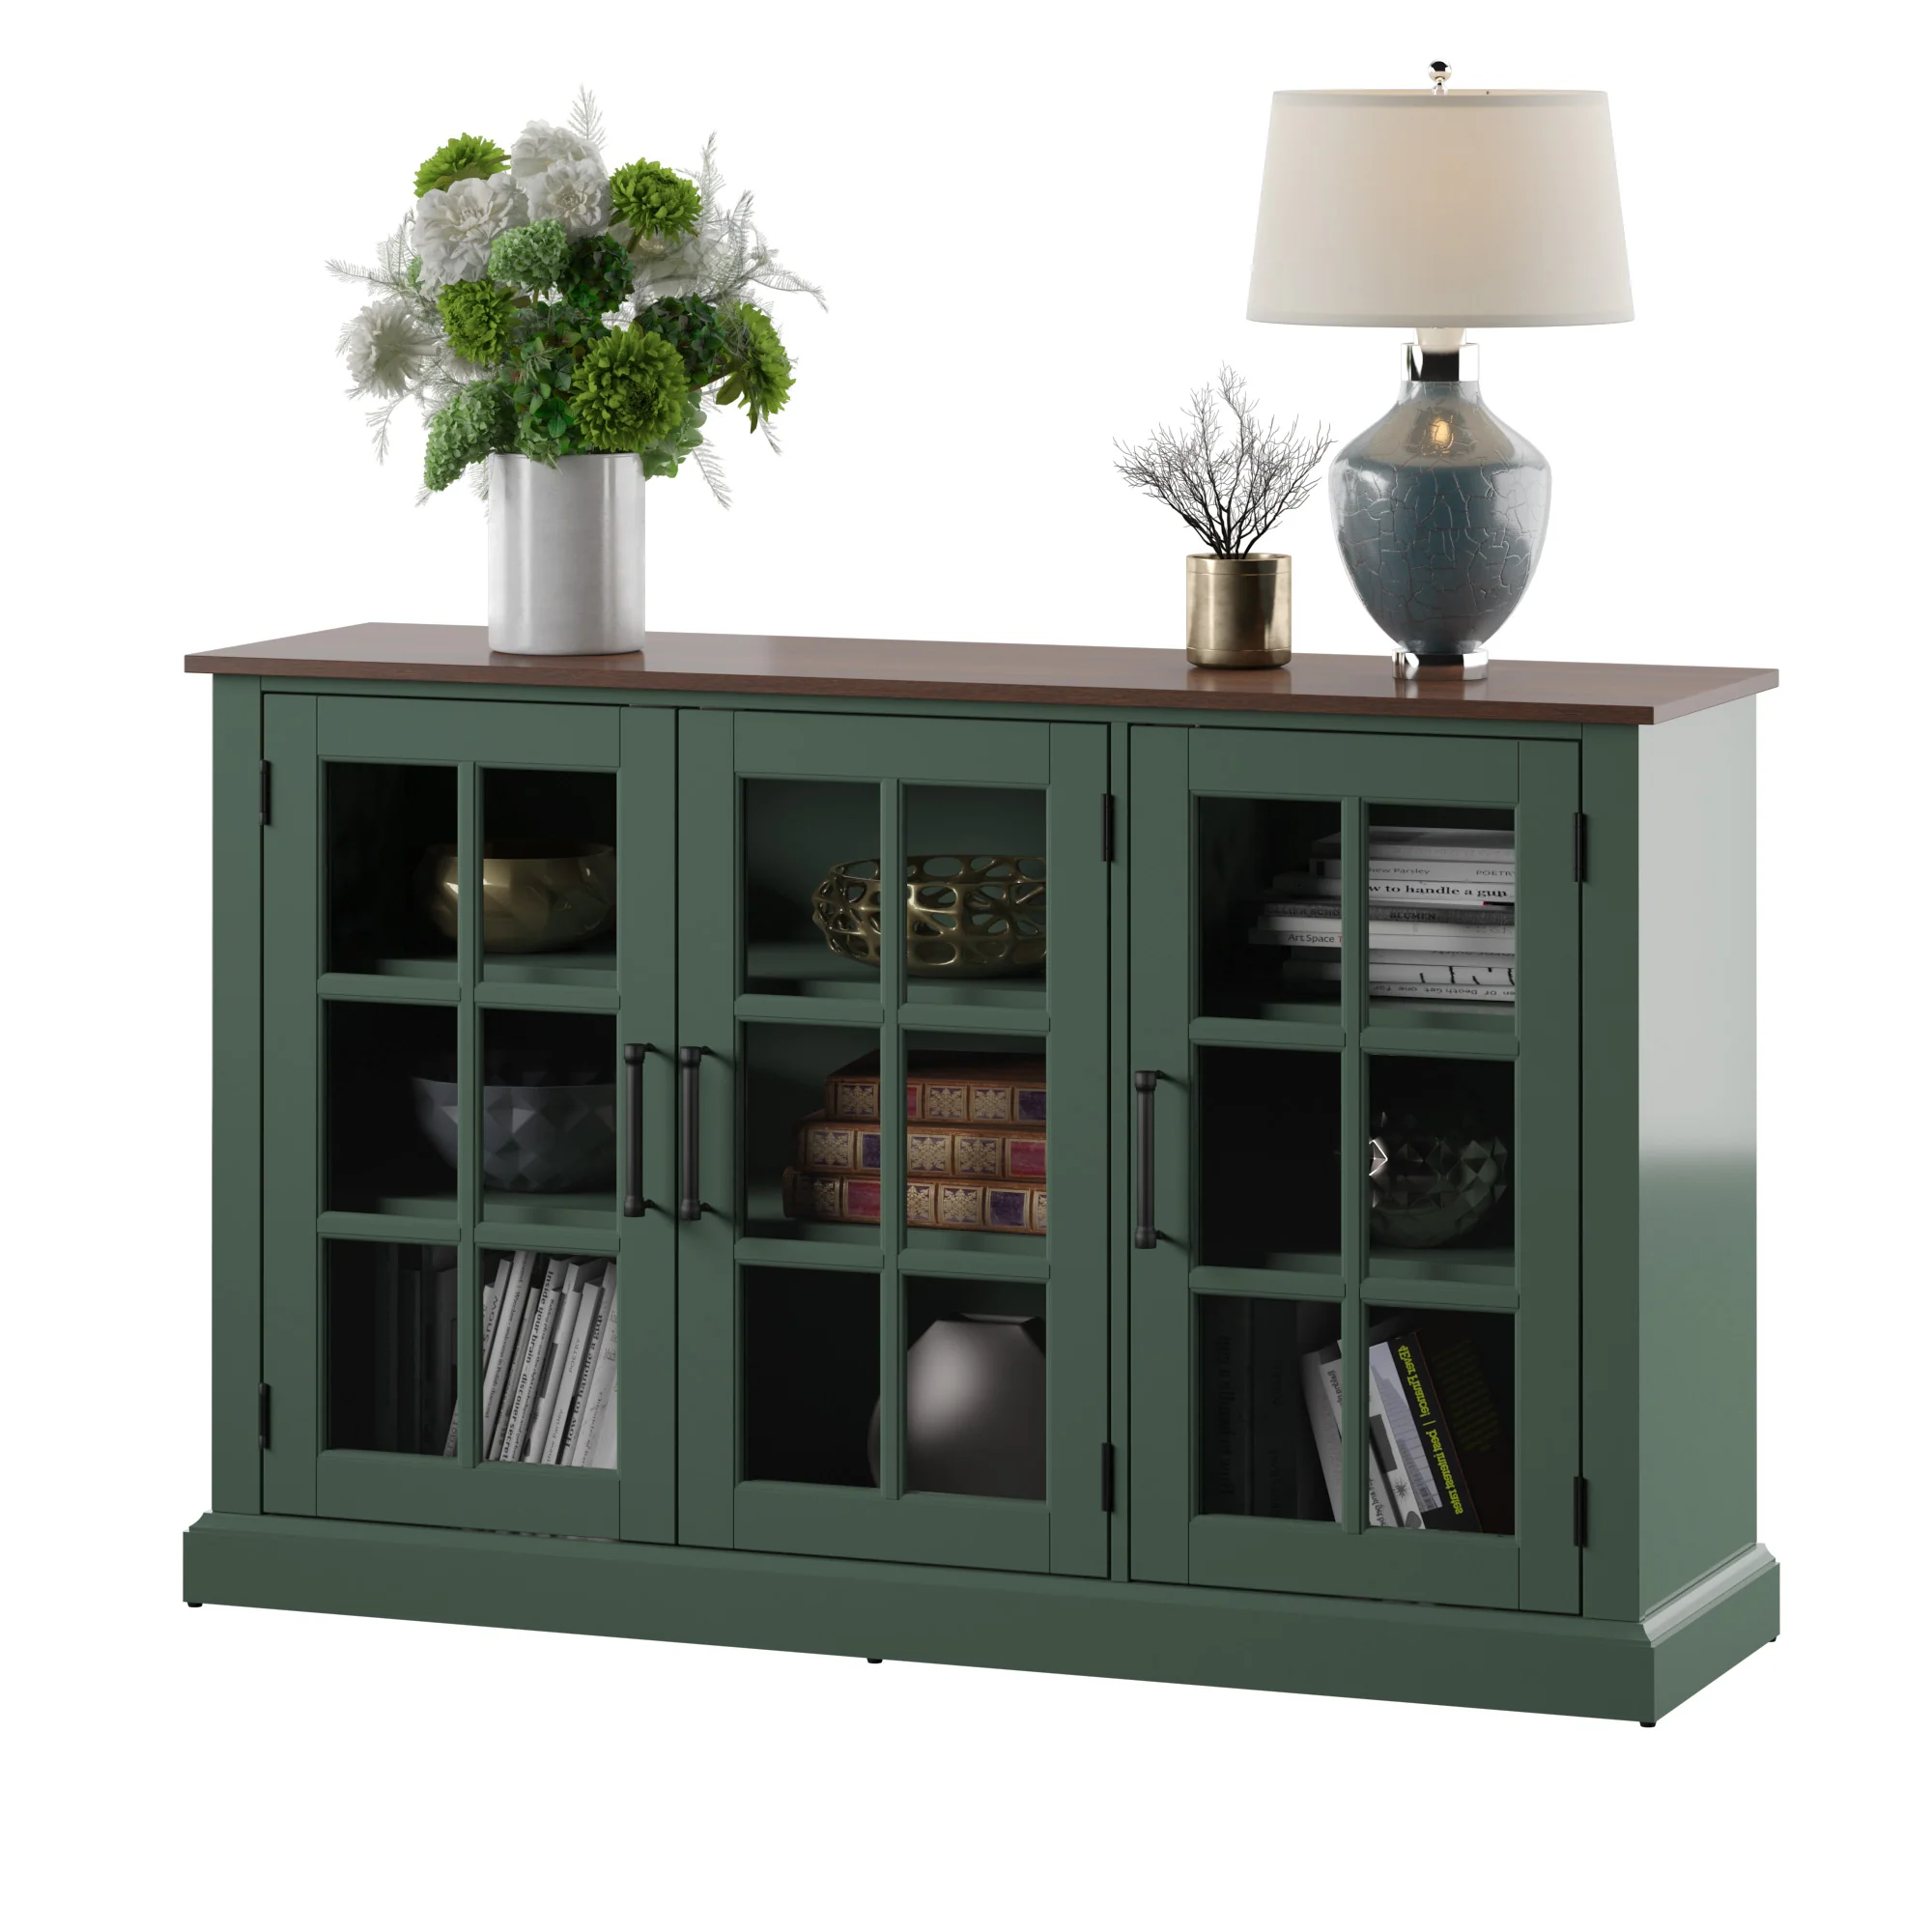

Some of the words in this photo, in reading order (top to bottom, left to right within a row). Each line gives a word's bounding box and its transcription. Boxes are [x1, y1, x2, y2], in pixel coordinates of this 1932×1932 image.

[1406, 885, 1460, 895] handle
[1306, 934, 1335, 943] Space
[540, 1270, 554, 1305] Inside
[532, 1307, 544, 1334] your
[526, 1334, 537, 1364] brain
[512, 1374, 528, 1422] discover
